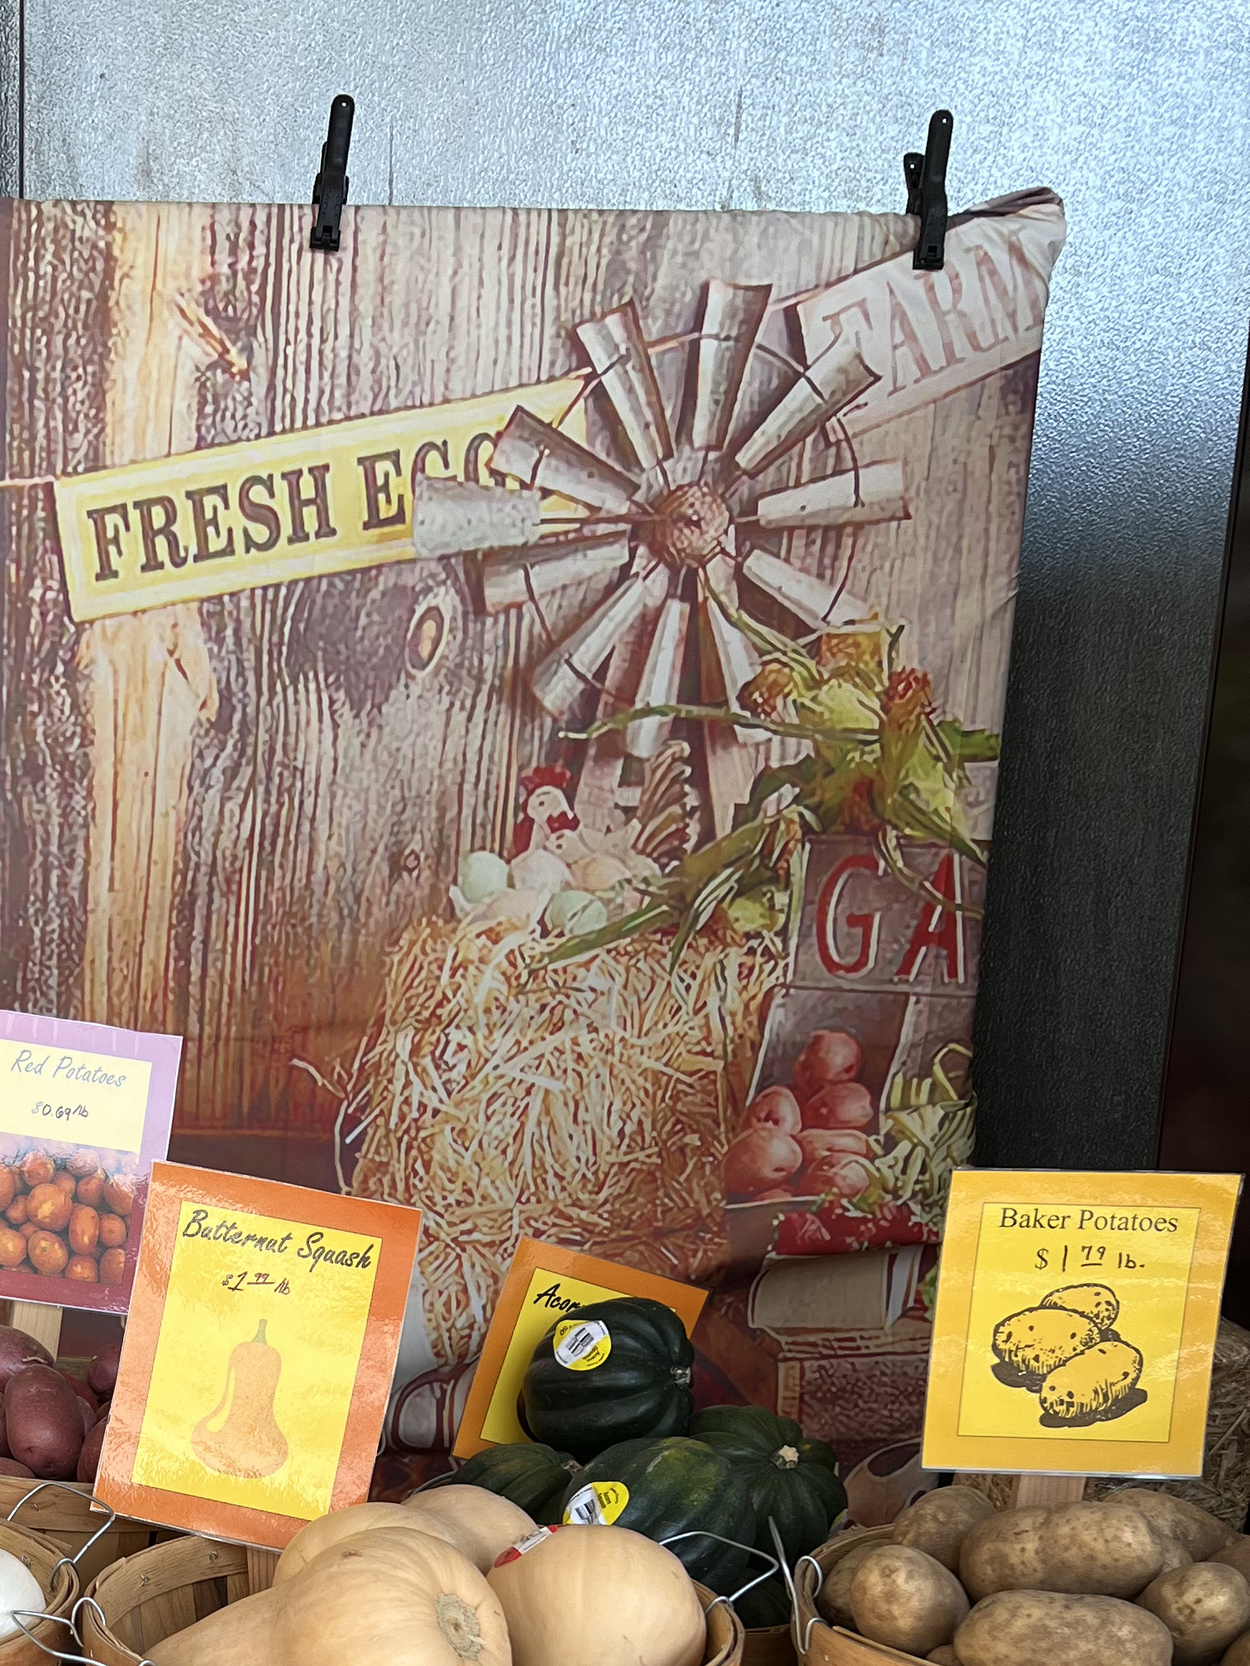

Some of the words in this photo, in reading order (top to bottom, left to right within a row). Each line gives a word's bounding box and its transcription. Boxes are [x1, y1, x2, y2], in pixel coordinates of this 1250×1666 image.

[86, 463, 337, 582] FRESH
[10, 1049, 50, 1075] Red
[52, 1055, 127, 1088] Potatoes
[999, 1207, 1071, 1230] Baker
[1078, 1209, 1179, 1233] Potatoes
[182, 1209, 293, 1253] Butternut
[297, 1231, 375, 1273] Squash
[533, 1283, 585, 1313] Acor
